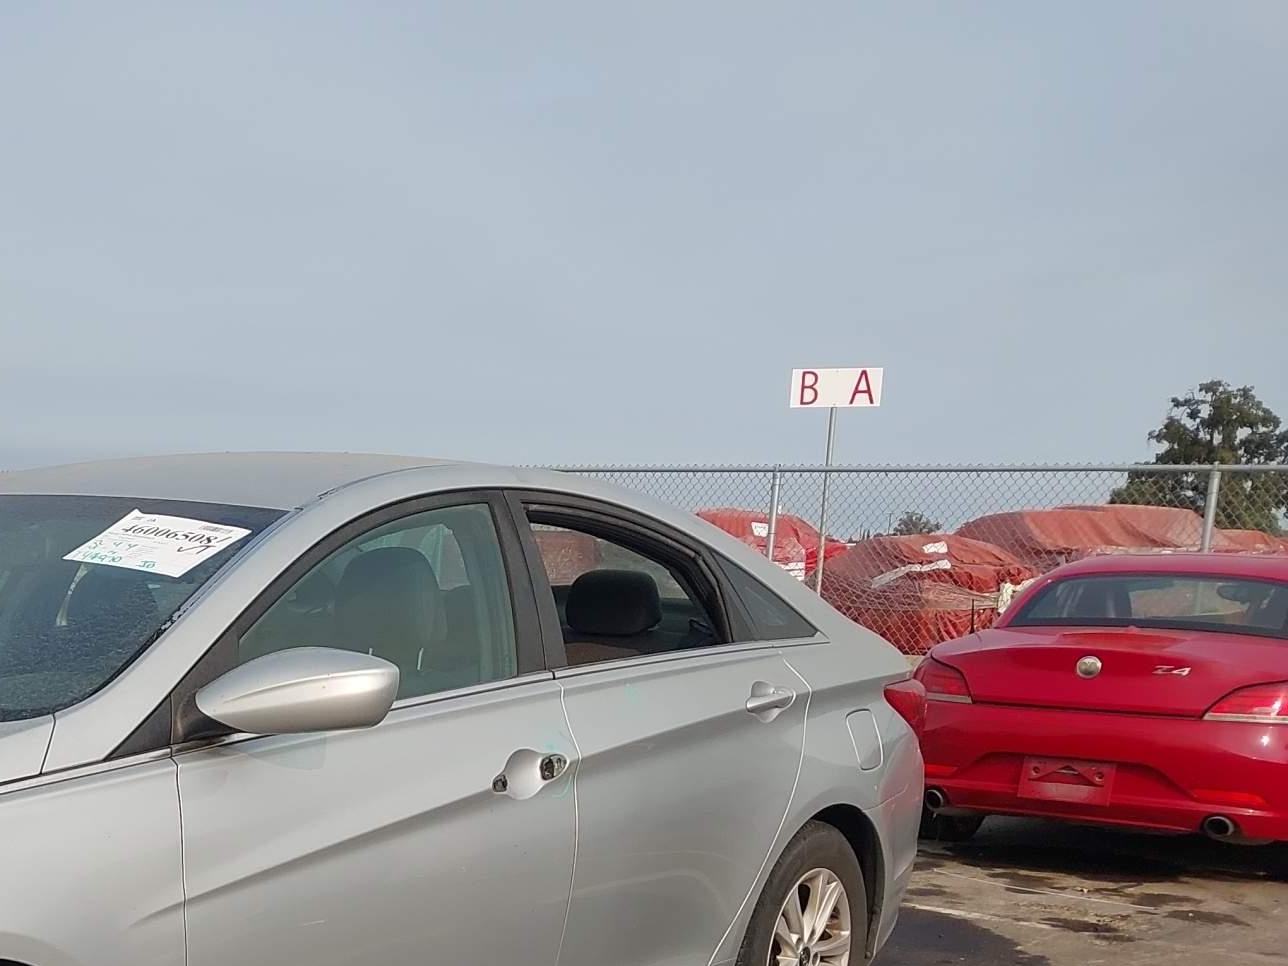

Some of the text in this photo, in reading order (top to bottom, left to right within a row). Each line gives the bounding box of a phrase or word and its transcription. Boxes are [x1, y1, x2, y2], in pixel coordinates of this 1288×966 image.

[800, 370, 874, 405] B A
[1152, 665, 1191, 676] Z4
